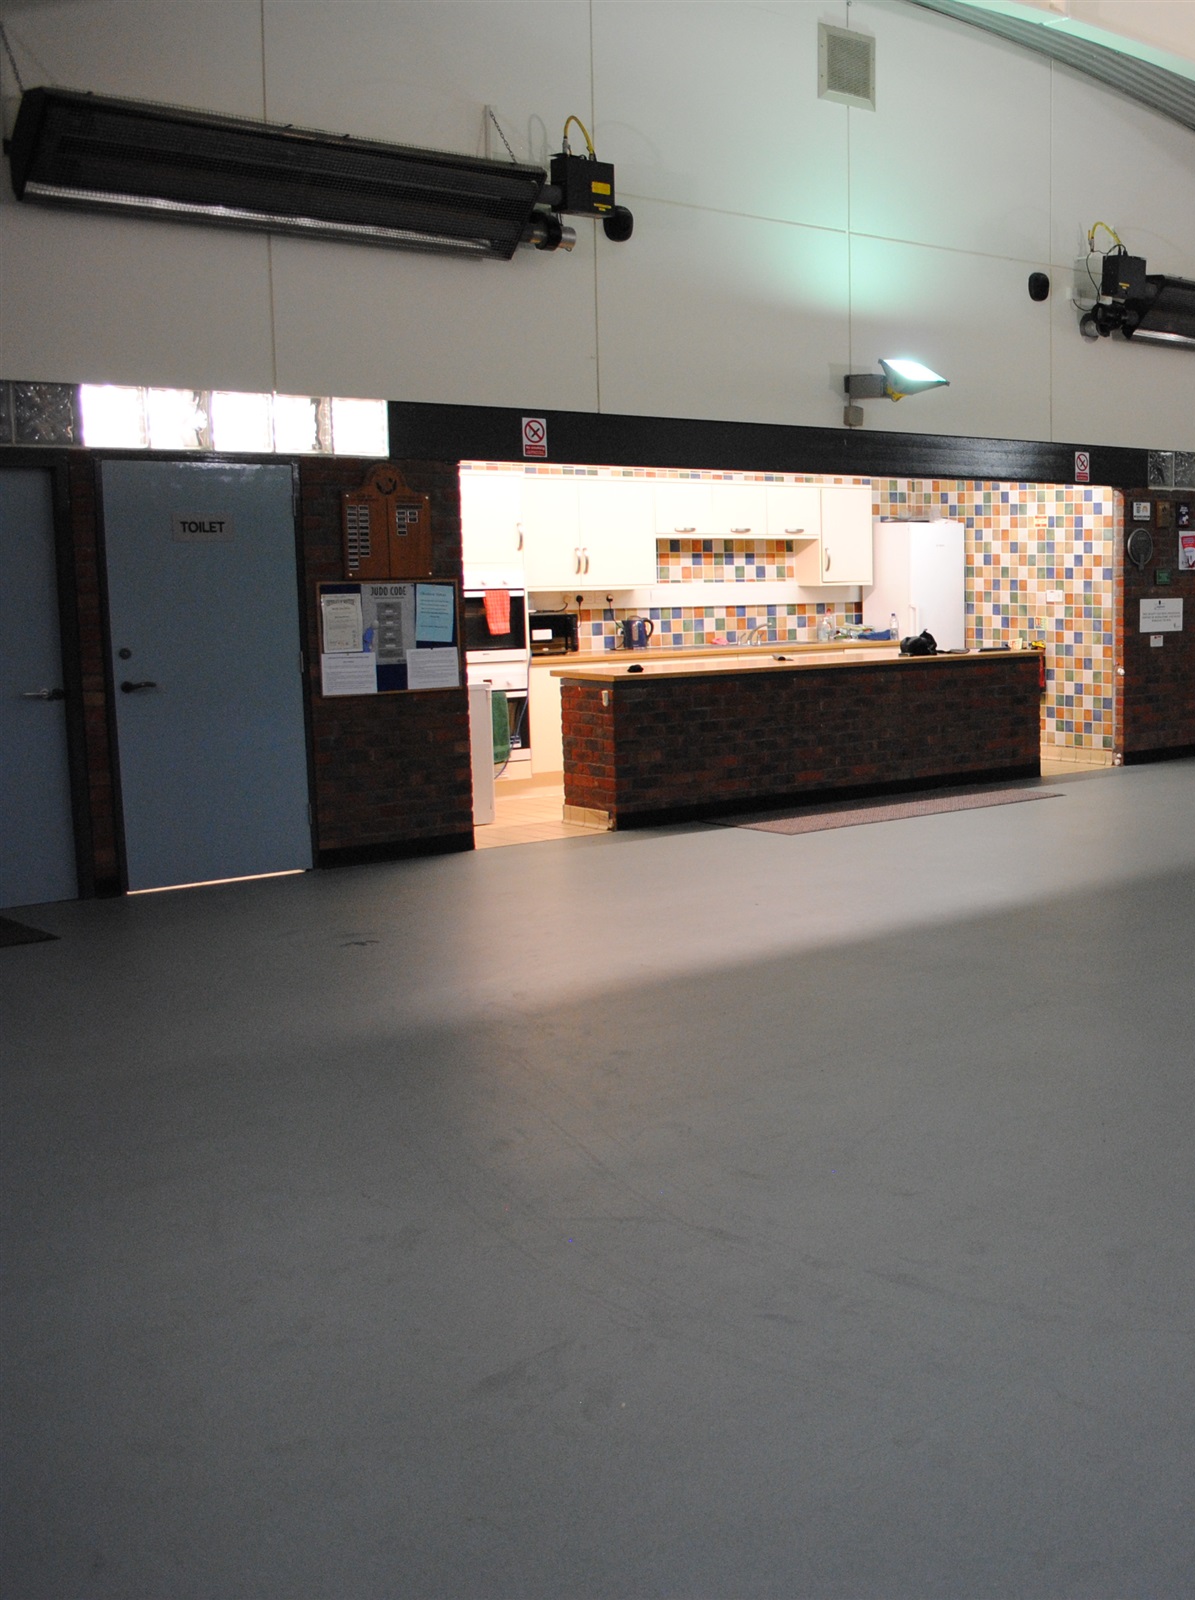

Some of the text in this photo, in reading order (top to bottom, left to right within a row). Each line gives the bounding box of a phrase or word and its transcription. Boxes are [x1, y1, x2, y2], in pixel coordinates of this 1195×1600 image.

[180, 521, 225, 533] TOILET
[370, 586, 406, 596] JUDO CODE
